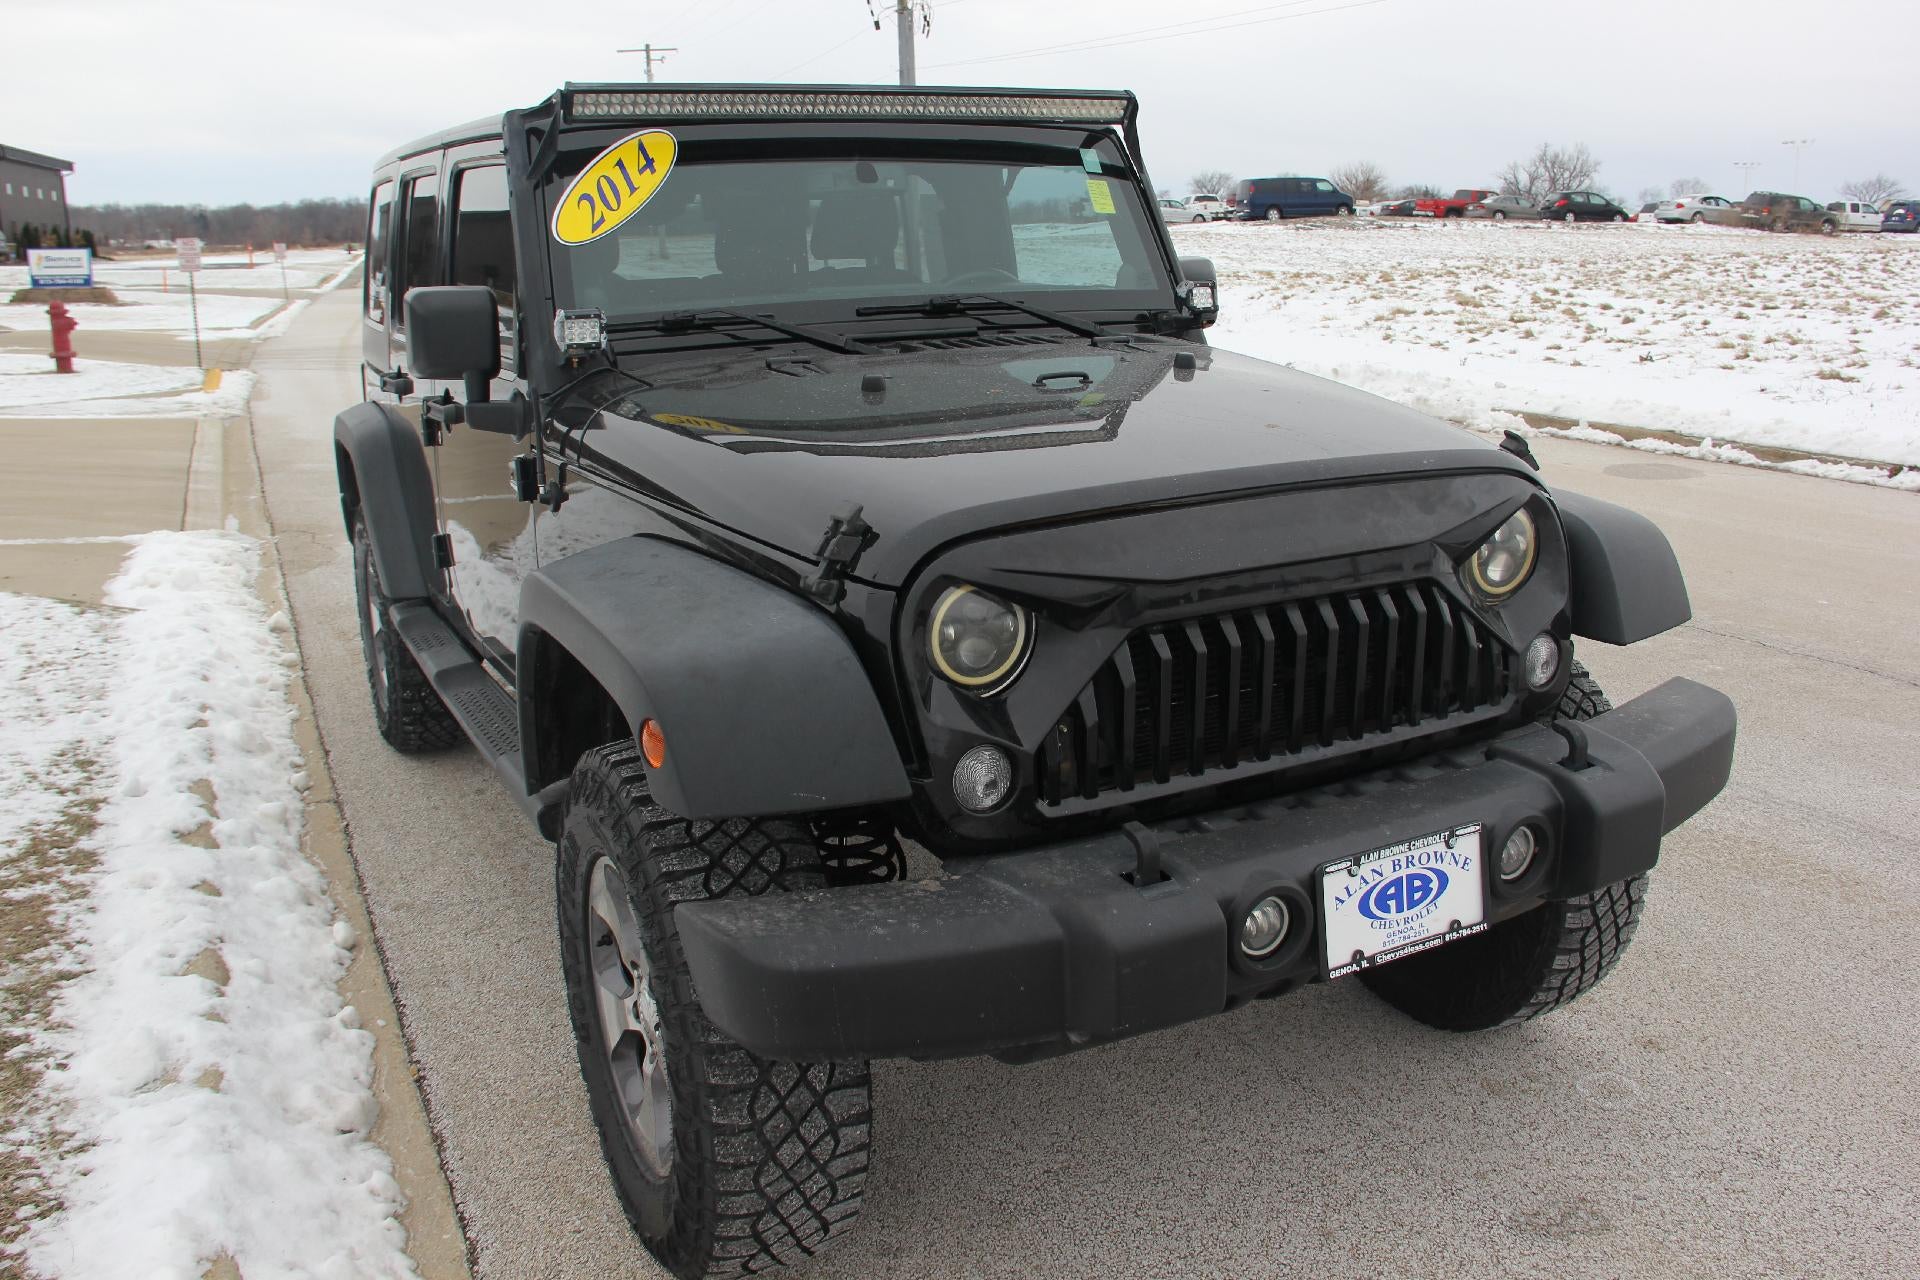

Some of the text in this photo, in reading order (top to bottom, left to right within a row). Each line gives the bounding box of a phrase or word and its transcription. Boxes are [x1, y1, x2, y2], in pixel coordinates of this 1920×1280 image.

[577, 138, 657, 234] 2014
[1359, 831, 1450, 865] ALAN BROWNE CHEVROLET
[1334, 850, 1472, 911] ALAN BROWNE
[1373, 872, 1435, 914] AB
[1370, 901, 1440, 930] CHEVROLET
[1445, 923, 1488, 942] 815-784-2511
[1376, 938, 1441, 964] Chevys4less.com
[1329, 960, 1370, 979] GENOA, IL
